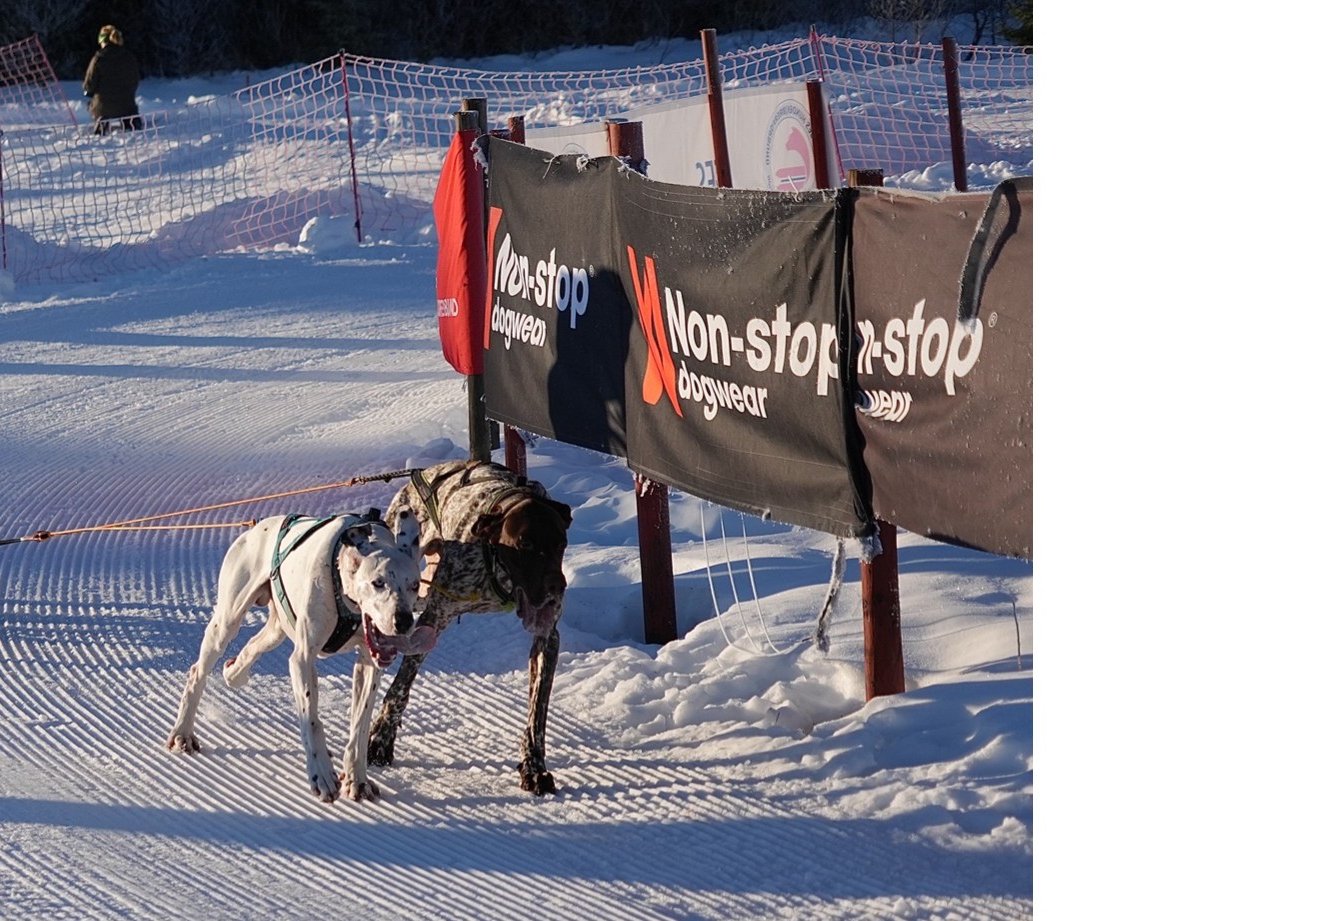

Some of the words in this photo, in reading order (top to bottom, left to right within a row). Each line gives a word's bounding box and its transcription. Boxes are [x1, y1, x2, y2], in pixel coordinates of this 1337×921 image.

[494, 232, 590, 330] Non-stop
[491, 296, 547, 351] dogwear
[664, 286, 840, 397] Non-stop
[678, 360, 768, 422] dogwear
